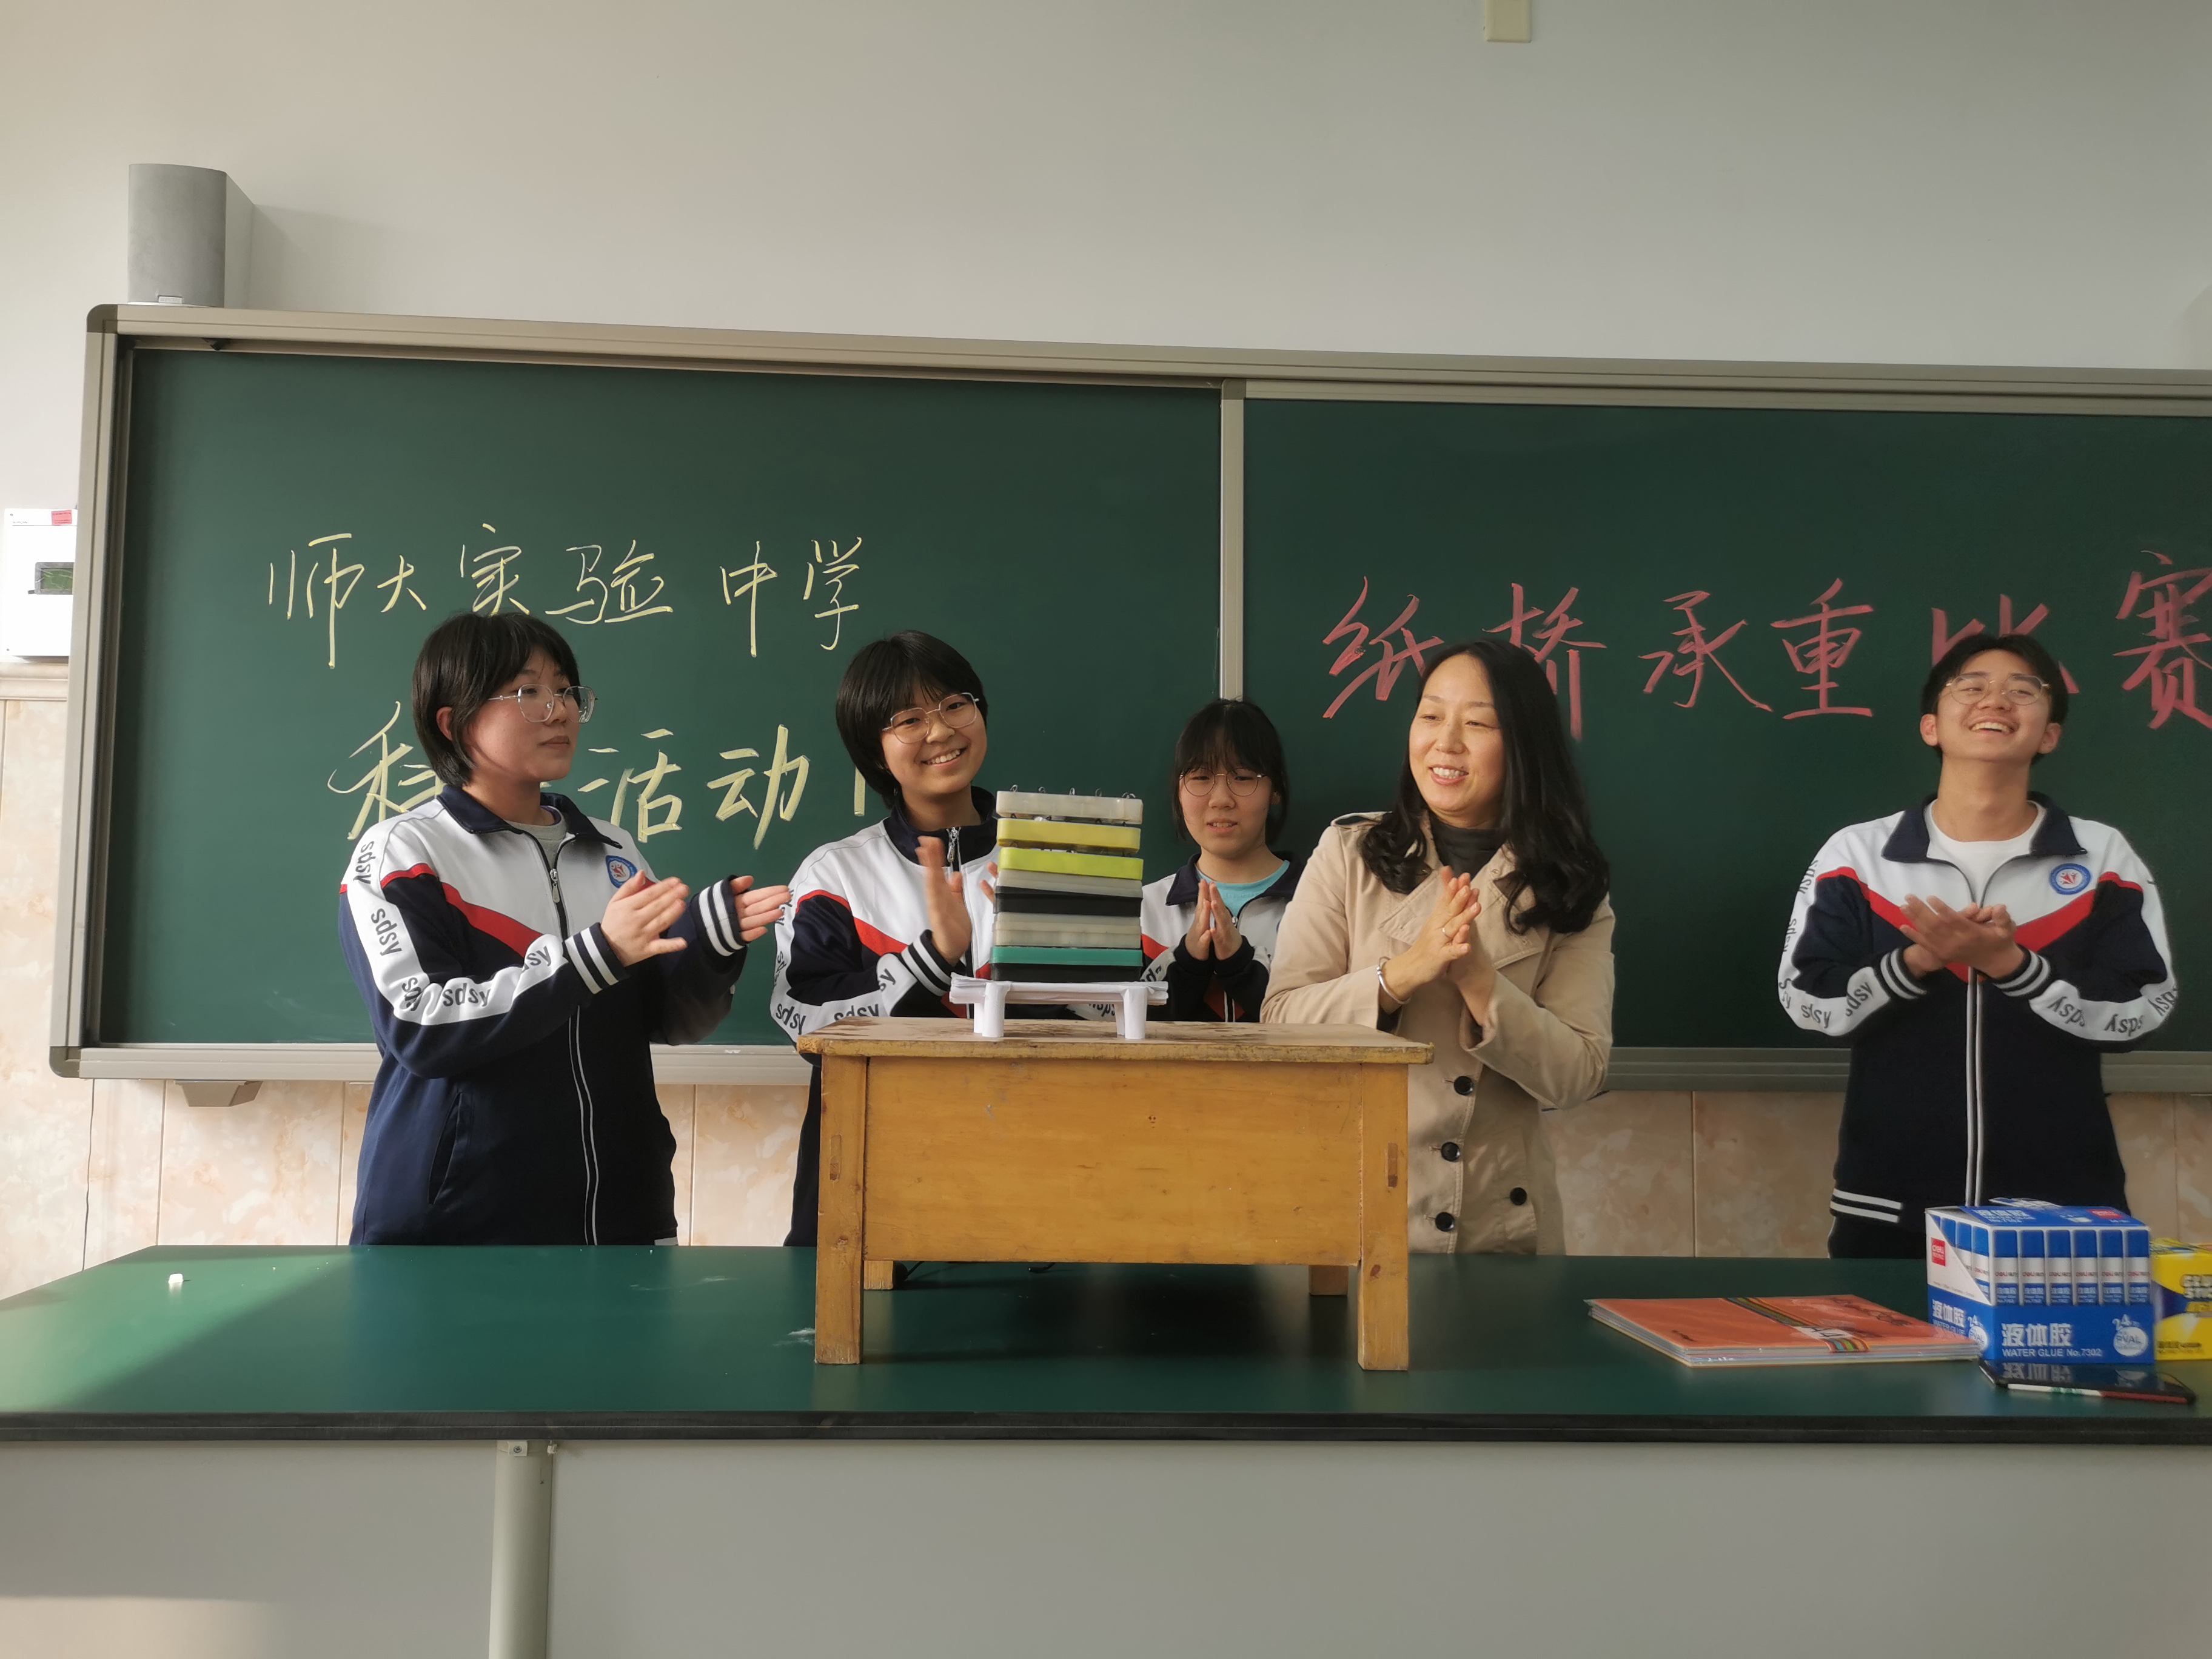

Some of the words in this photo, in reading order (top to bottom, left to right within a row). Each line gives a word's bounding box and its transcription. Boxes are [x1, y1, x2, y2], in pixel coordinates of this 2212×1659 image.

[269, 523, 862, 669] 师大实验中学
[370, 908, 403, 956] sdsy
[442, 982, 491, 1007] sdsy
[775, 1003, 806, 1036] sdsy
[2001, 1323, 2073, 1347] 液体胶
[2002, 1348, 2036, 1357] WATER
[2037, 1348, 2063, 1357] GLUE
